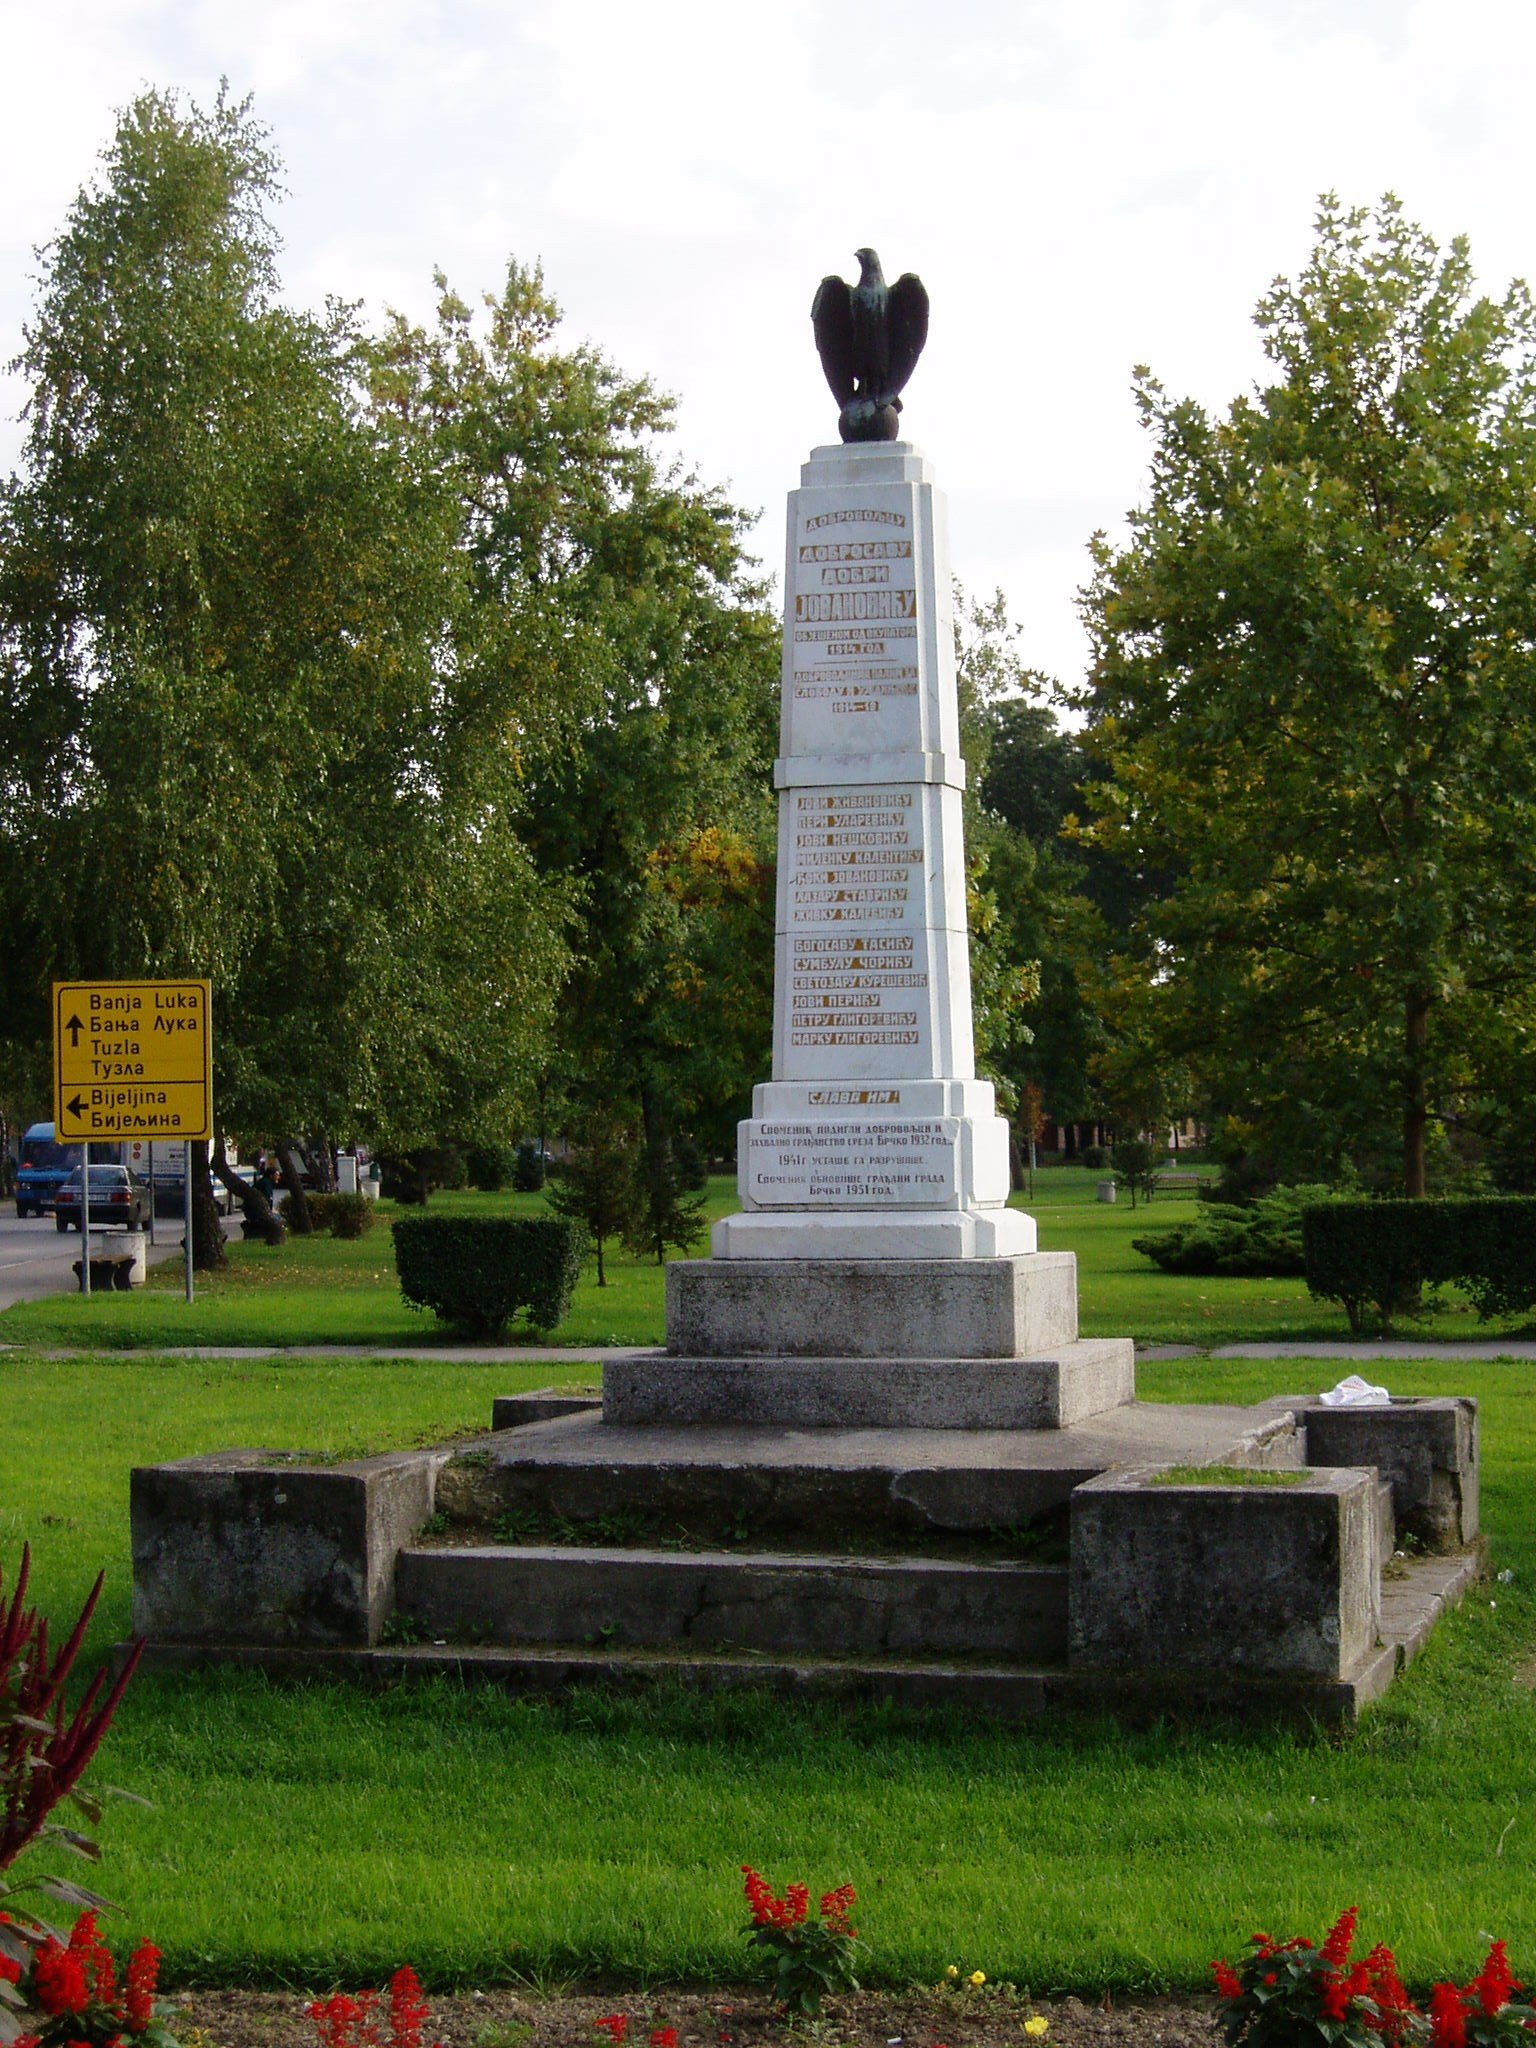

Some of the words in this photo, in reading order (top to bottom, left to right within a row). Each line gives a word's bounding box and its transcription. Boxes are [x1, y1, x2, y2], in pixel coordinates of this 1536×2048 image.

[800, 541, 911, 563] ДОБРОСАВУ
[822, 565, 889, 585] ДОБРИ
[796, 590, 917, 622] ЈОВАНОВИЋУ
[828, 644, 856, 655] 1914
[832, 794, 912, 808] ЖИВАНОВИЋУ
[799, 816, 828, 828] ПЕРИ
[798, 834, 827, 847] ЈОВИ
[833, 832, 908, 845] НЕШКОВИЋУ
[832, 869, 908, 884] ЈОВАНОВИЋУ
[843, 888, 907, 902] СТАВРИЋУ
[795, 939, 856, 952] БОГОСАВУ
[861, 937, 912, 950] ТАСИЋУ
[794, 958, 855, 971] СУМБУЛУ
[793, 976, 856, 990] СВЕТОЗАРУ
[90, 994, 142, 1013] Banja
[155, 993, 198, 1009] Luka
[793, 995, 824, 1008] ЈОВИ
[829, 994, 880, 1007] ПЕРИЋУ
[90, 1017, 140, 1032] Бања
[154, 1015, 197, 1035] Лука
[792, 1014, 829, 1027] ПЕТРУ
[833, 1012, 916, 1026] ГЛИГОРЕВИЋУ
[792, 1033, 832, 1046] МАРКУ
[835, 1031, 918, 1044] ГЛИГОРЕВИЋУ
[91, 1039, 141, 1056] Tuzla
[91, 1060, 145, 1079] Тузла
[91, 1089, 167, 1109] Bijeljina
[809, 1091, 860, 1104] СЛАВА
[91, 1112, 181, 1131] Бијељина
[847, 1184, 870, 1196] 1951
